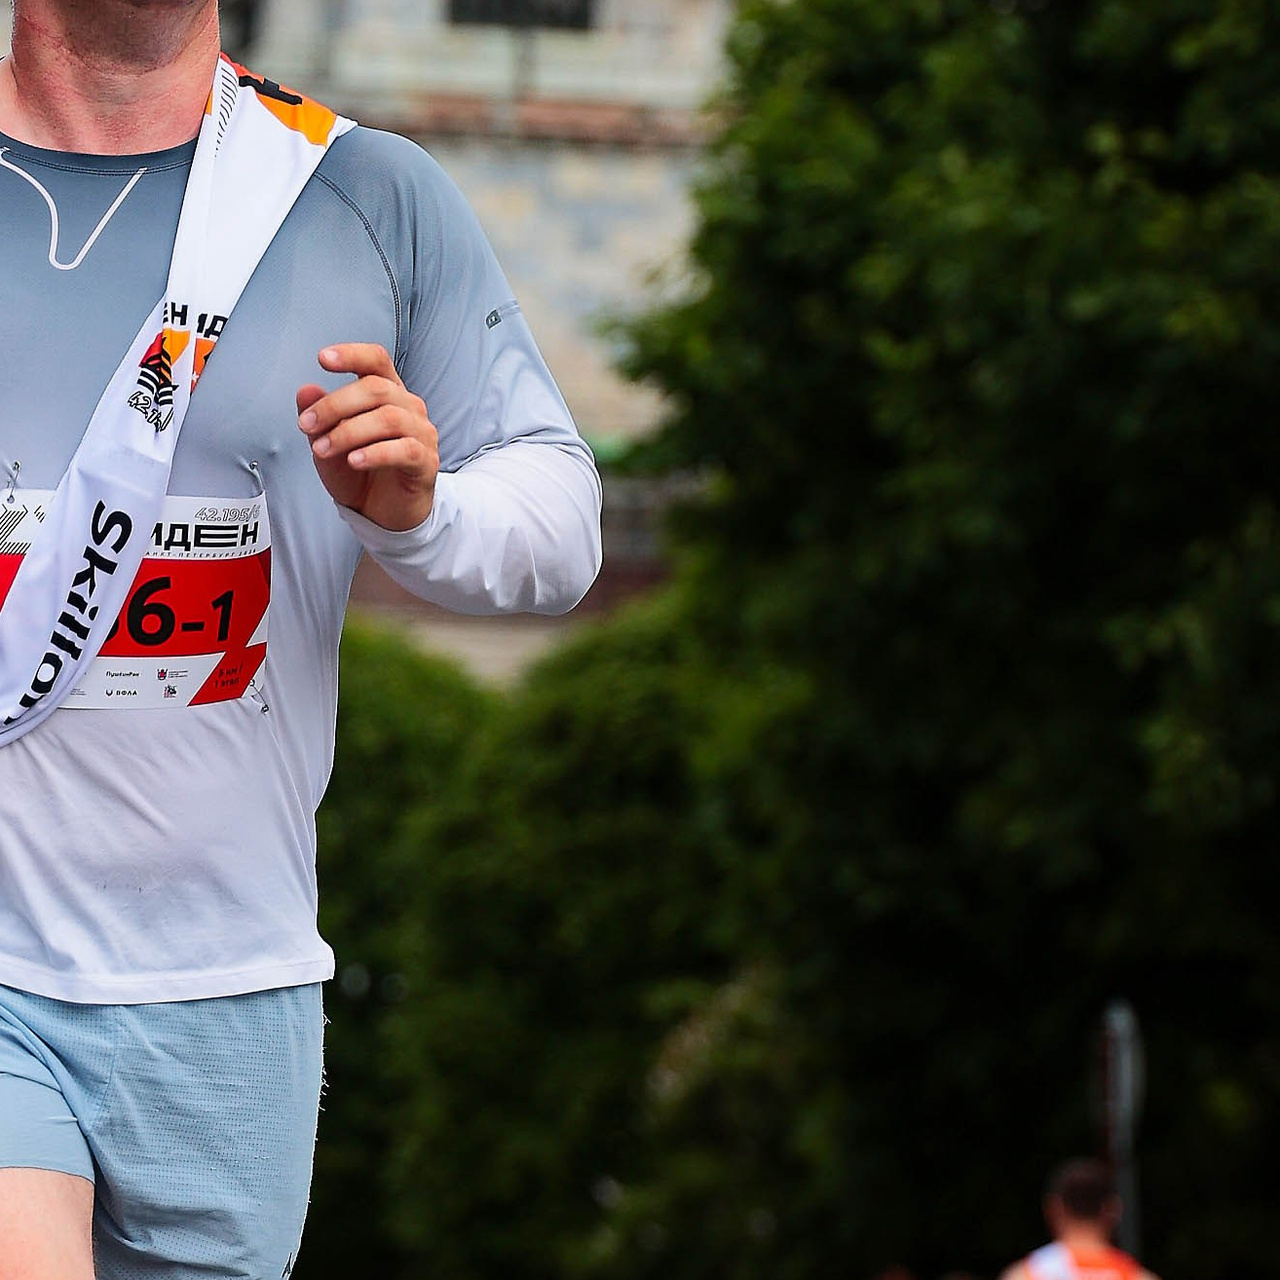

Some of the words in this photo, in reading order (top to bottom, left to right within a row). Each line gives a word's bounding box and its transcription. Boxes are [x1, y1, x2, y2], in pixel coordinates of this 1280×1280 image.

[150, 521, 259, 552] ИДЕН
[145, 550, 235, 559] АНКТ-ПЕТЕРБУРГ
[106, 576, 235, 647] 6-1
